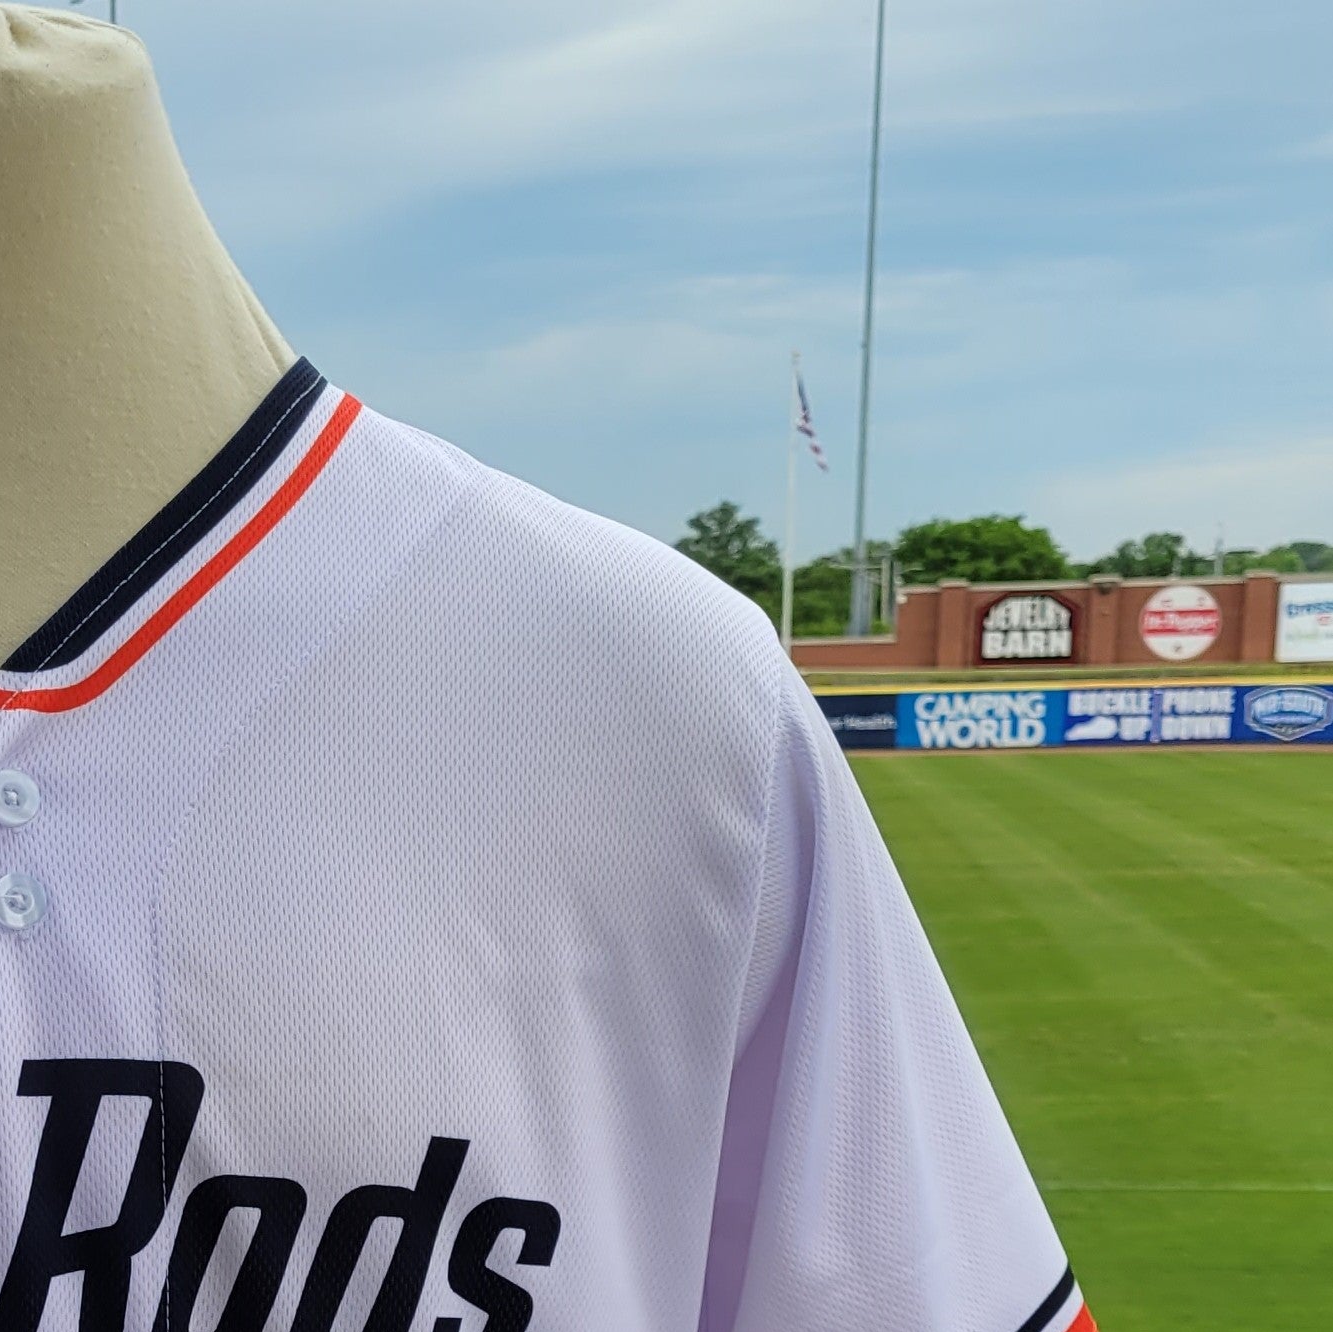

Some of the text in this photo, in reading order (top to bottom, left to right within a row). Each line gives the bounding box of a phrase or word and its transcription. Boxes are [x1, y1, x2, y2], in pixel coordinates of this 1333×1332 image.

[982, 630, 1072, 658] BARN
[915, 693, 1046, 720] CAMPING
[916, 719, 1046, 748] WORLD
